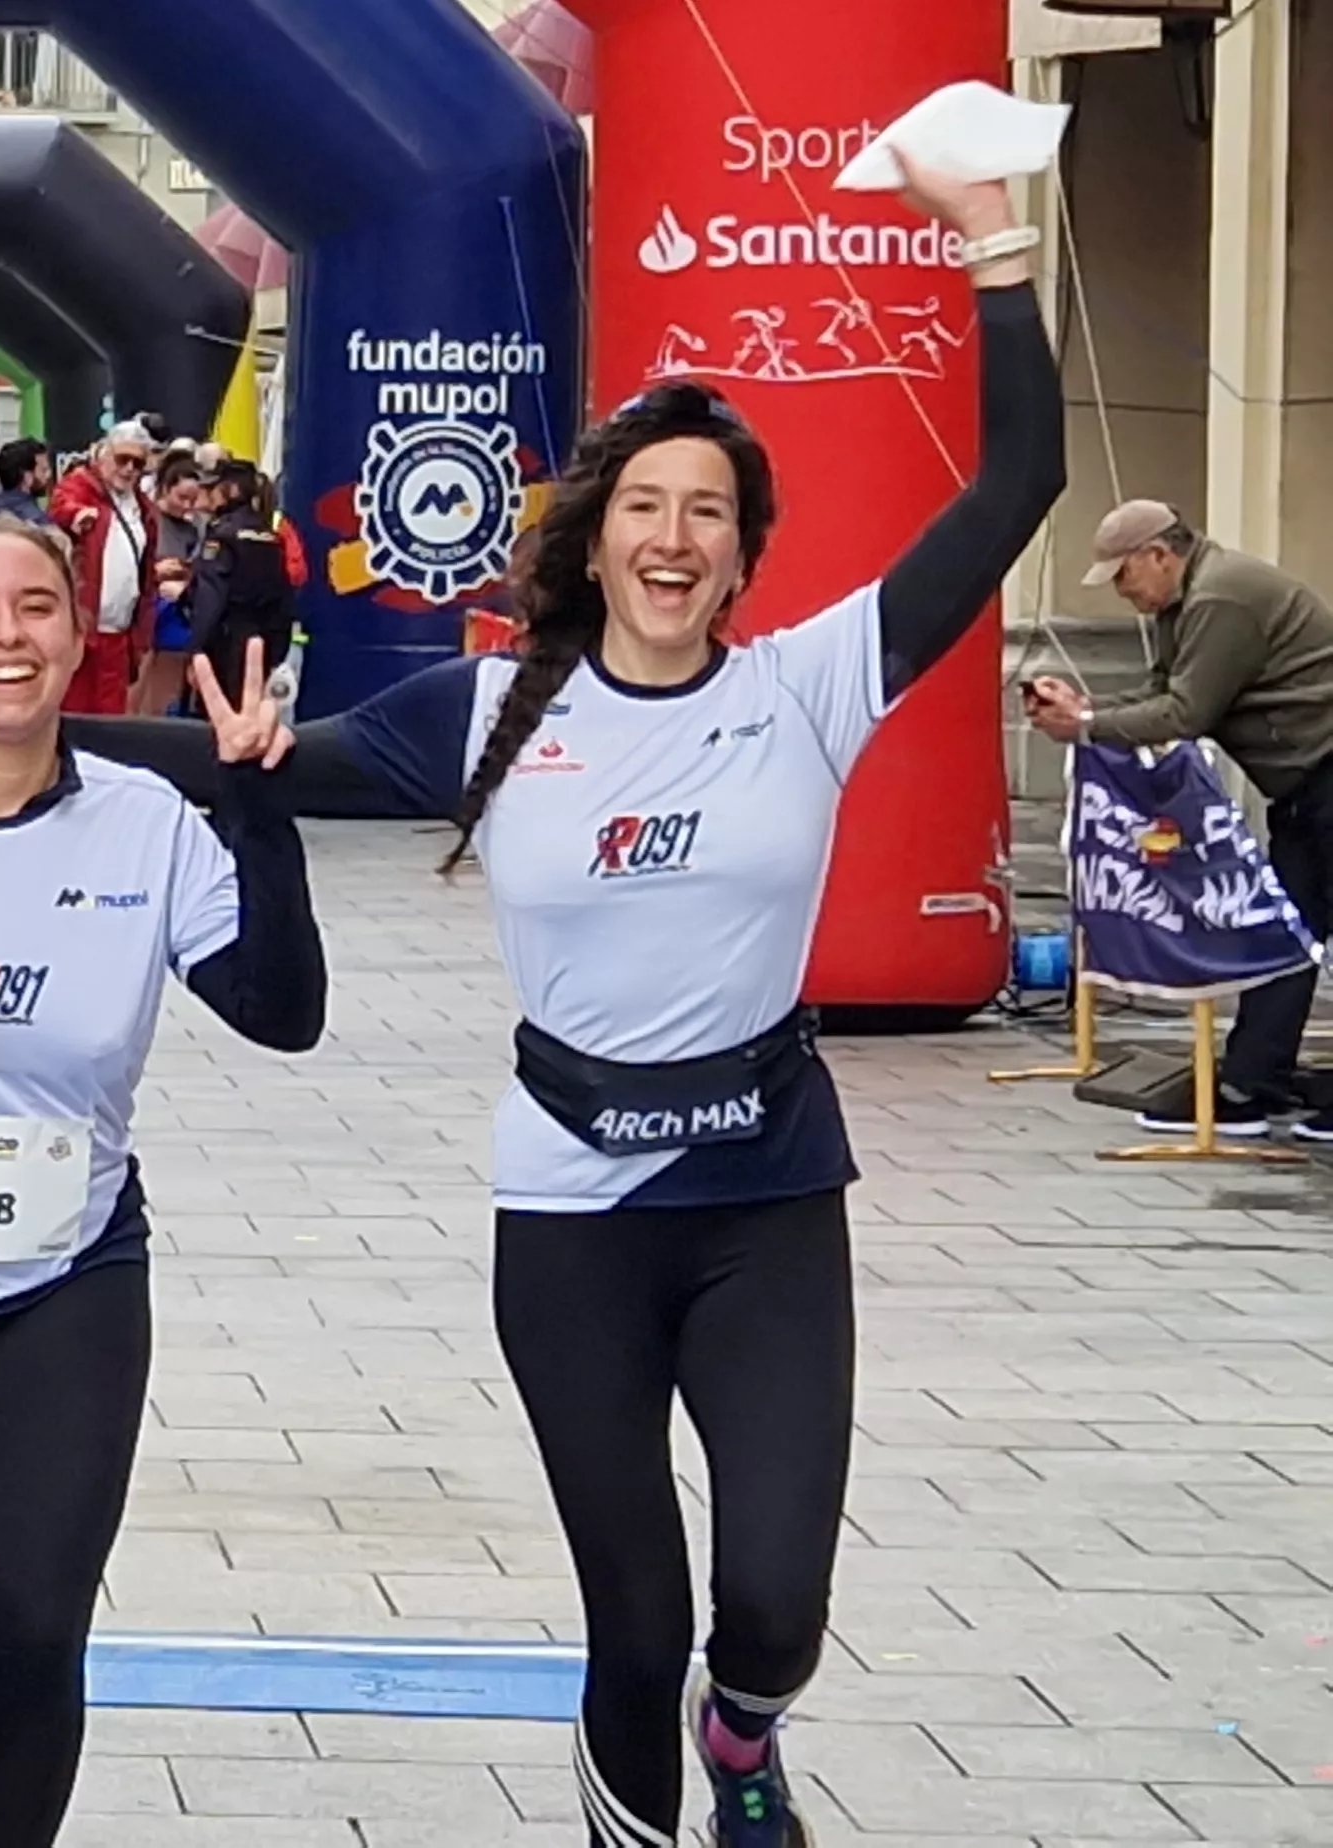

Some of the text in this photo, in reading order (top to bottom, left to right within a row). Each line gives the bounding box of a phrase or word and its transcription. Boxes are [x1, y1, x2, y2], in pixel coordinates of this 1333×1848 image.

[722, 115, 880, 182] Sport
[705, 213, 966, 269] Santande
[347, 329, 546, 375] fundación
[378, 375, 508, 421] mupol
[690, 1087, 766, 1134] MAX
